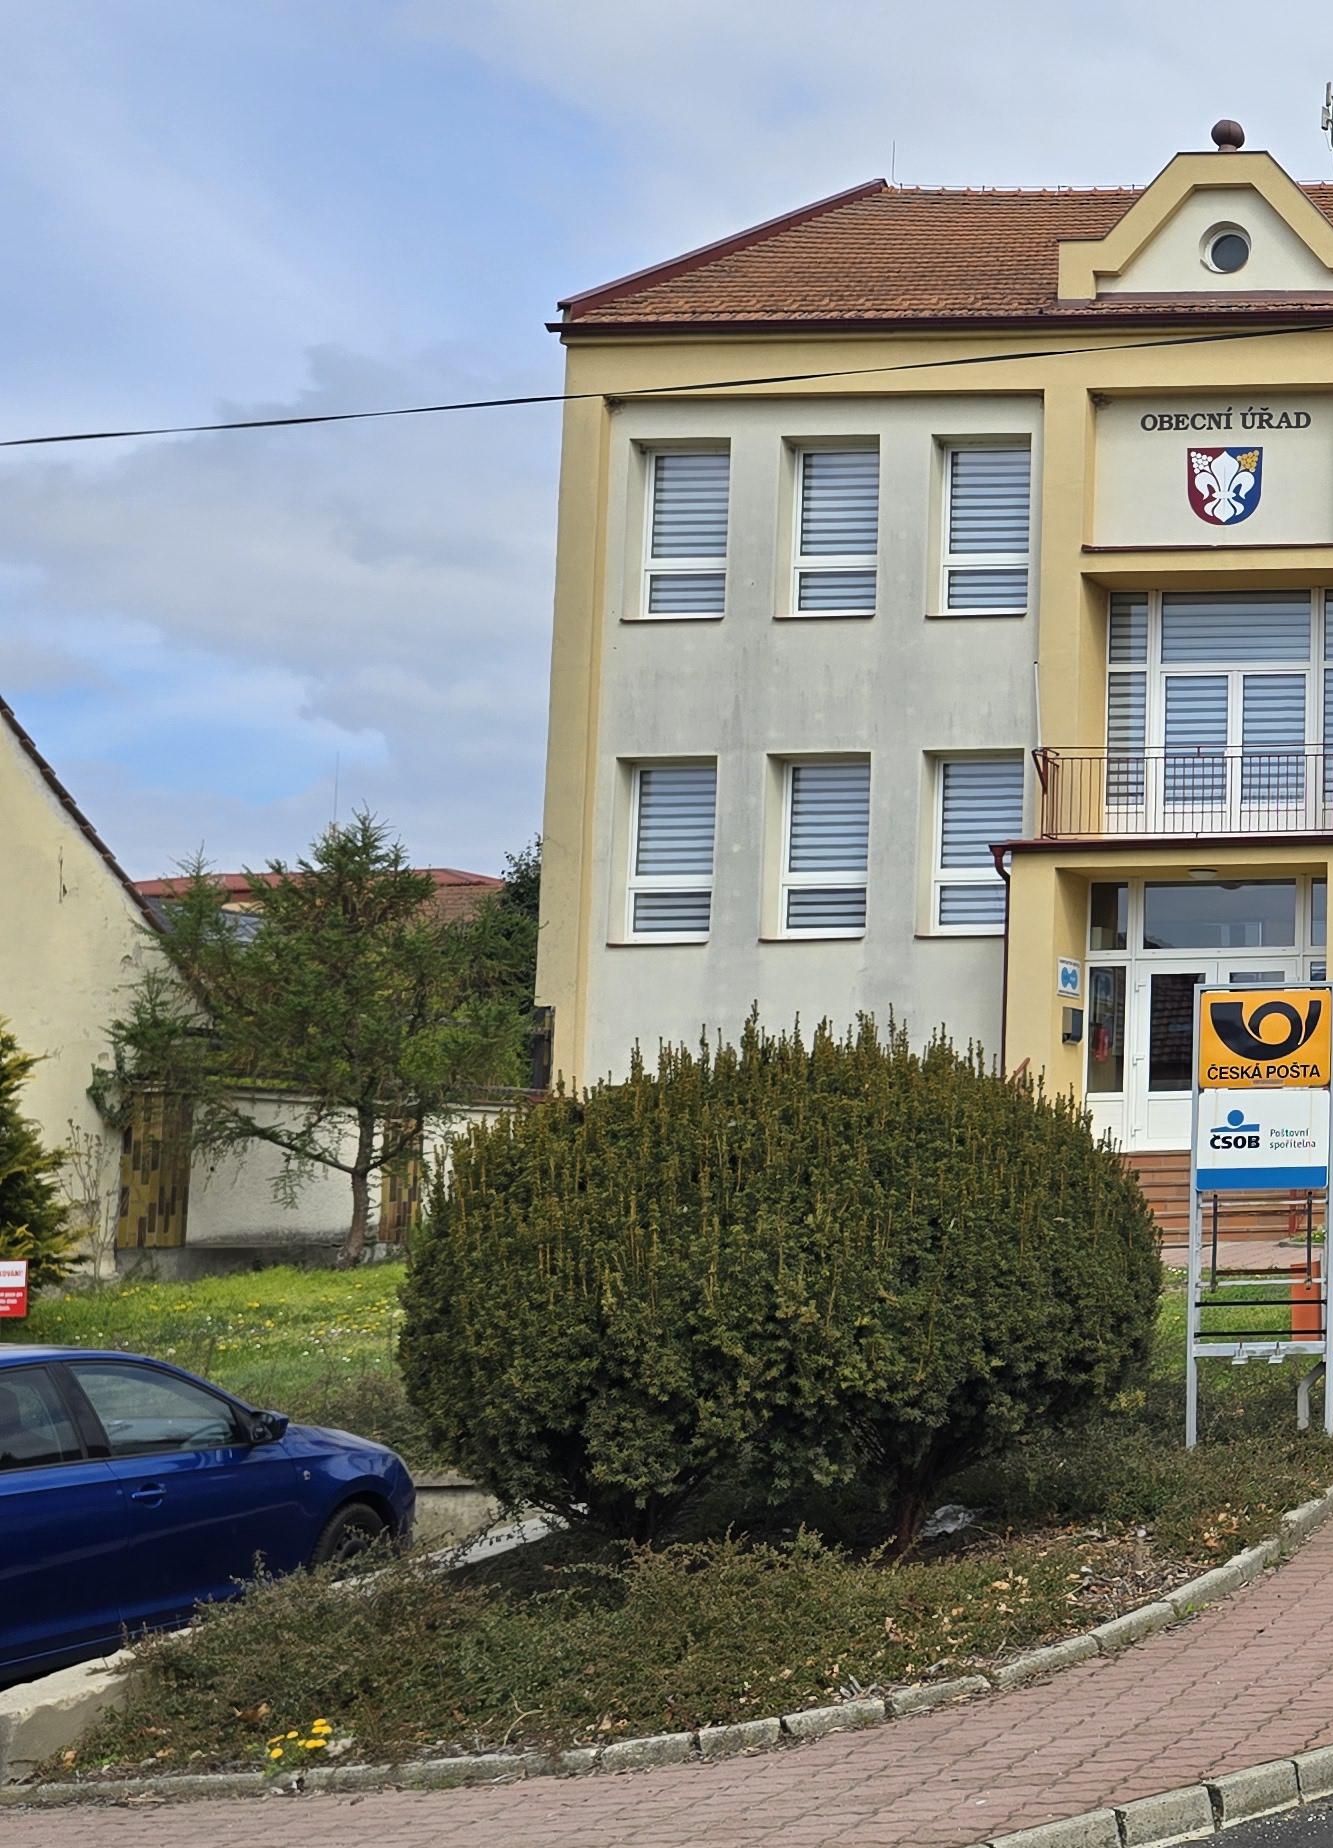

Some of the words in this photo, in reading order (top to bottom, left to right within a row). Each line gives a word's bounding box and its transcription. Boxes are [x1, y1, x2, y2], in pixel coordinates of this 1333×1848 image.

[1140, 406, 1233, 431] OBECNÍ
[1240, 406, 1311, 430] ÚŘAD
[1207, 1063, 1262, 1080] ČESKÁ
[1266, 1061, 1320, 1079] POŠTA
[1270, 1128, 1309, 1138] Poštovní
[1210, 1134, 1260, 1150] ČSOB
[1269, 1139, 1316, 1149] spořitelna
